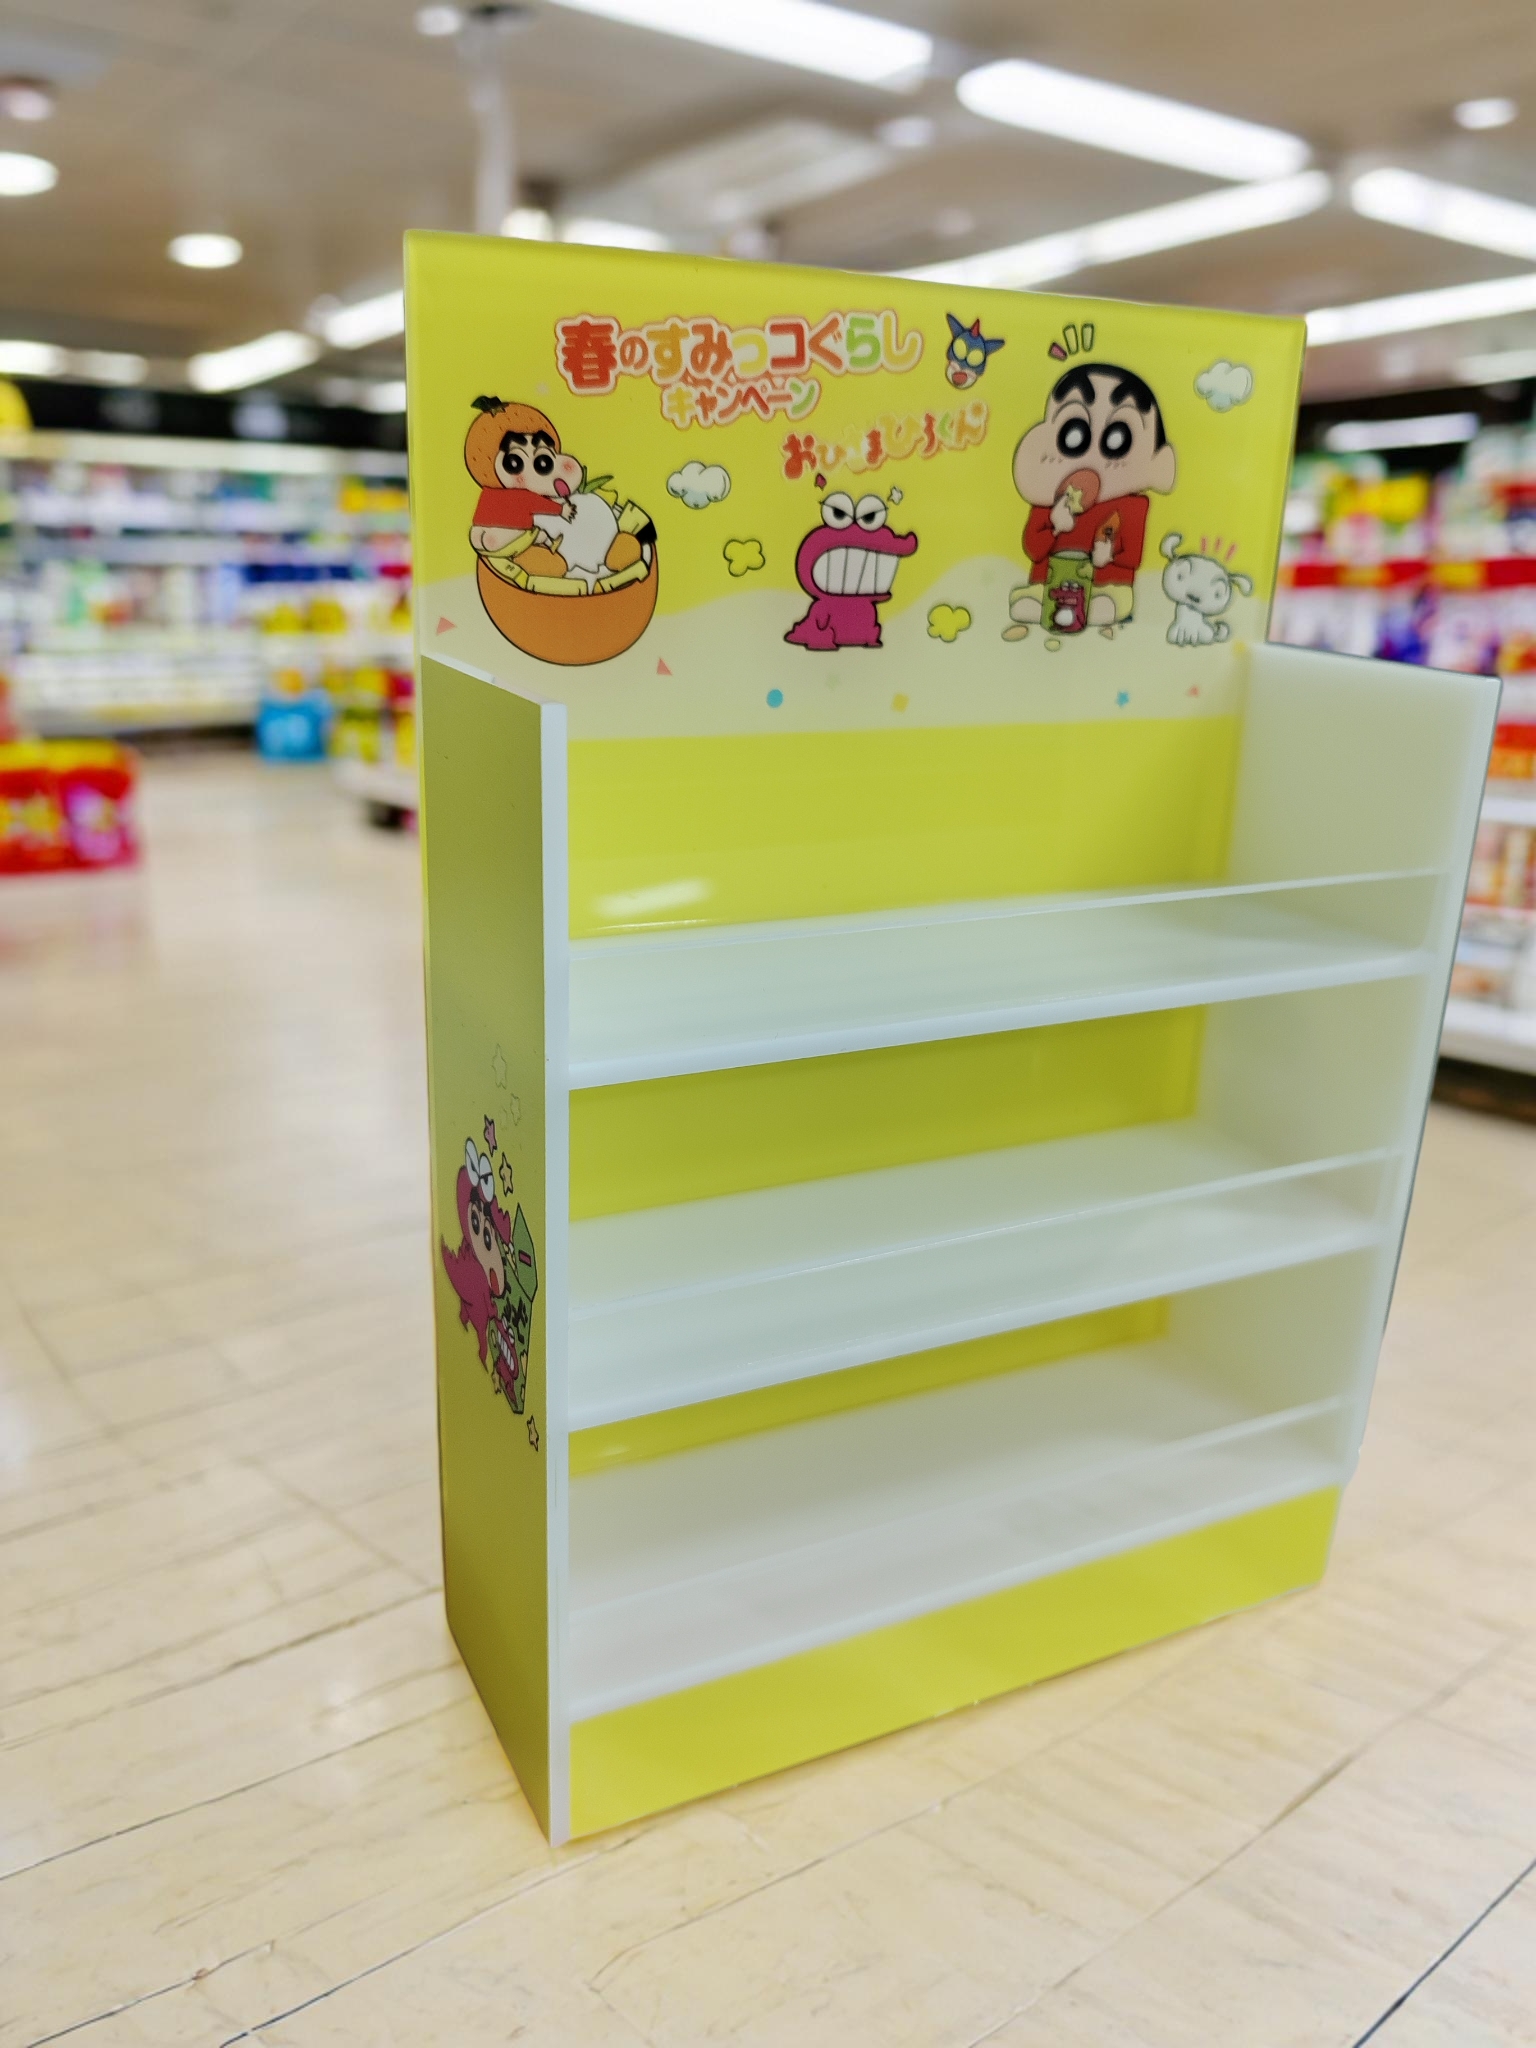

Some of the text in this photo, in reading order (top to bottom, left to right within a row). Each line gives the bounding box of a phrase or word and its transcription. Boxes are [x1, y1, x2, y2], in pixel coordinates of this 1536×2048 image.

[664, 381, 818, 424] キャンペーン
